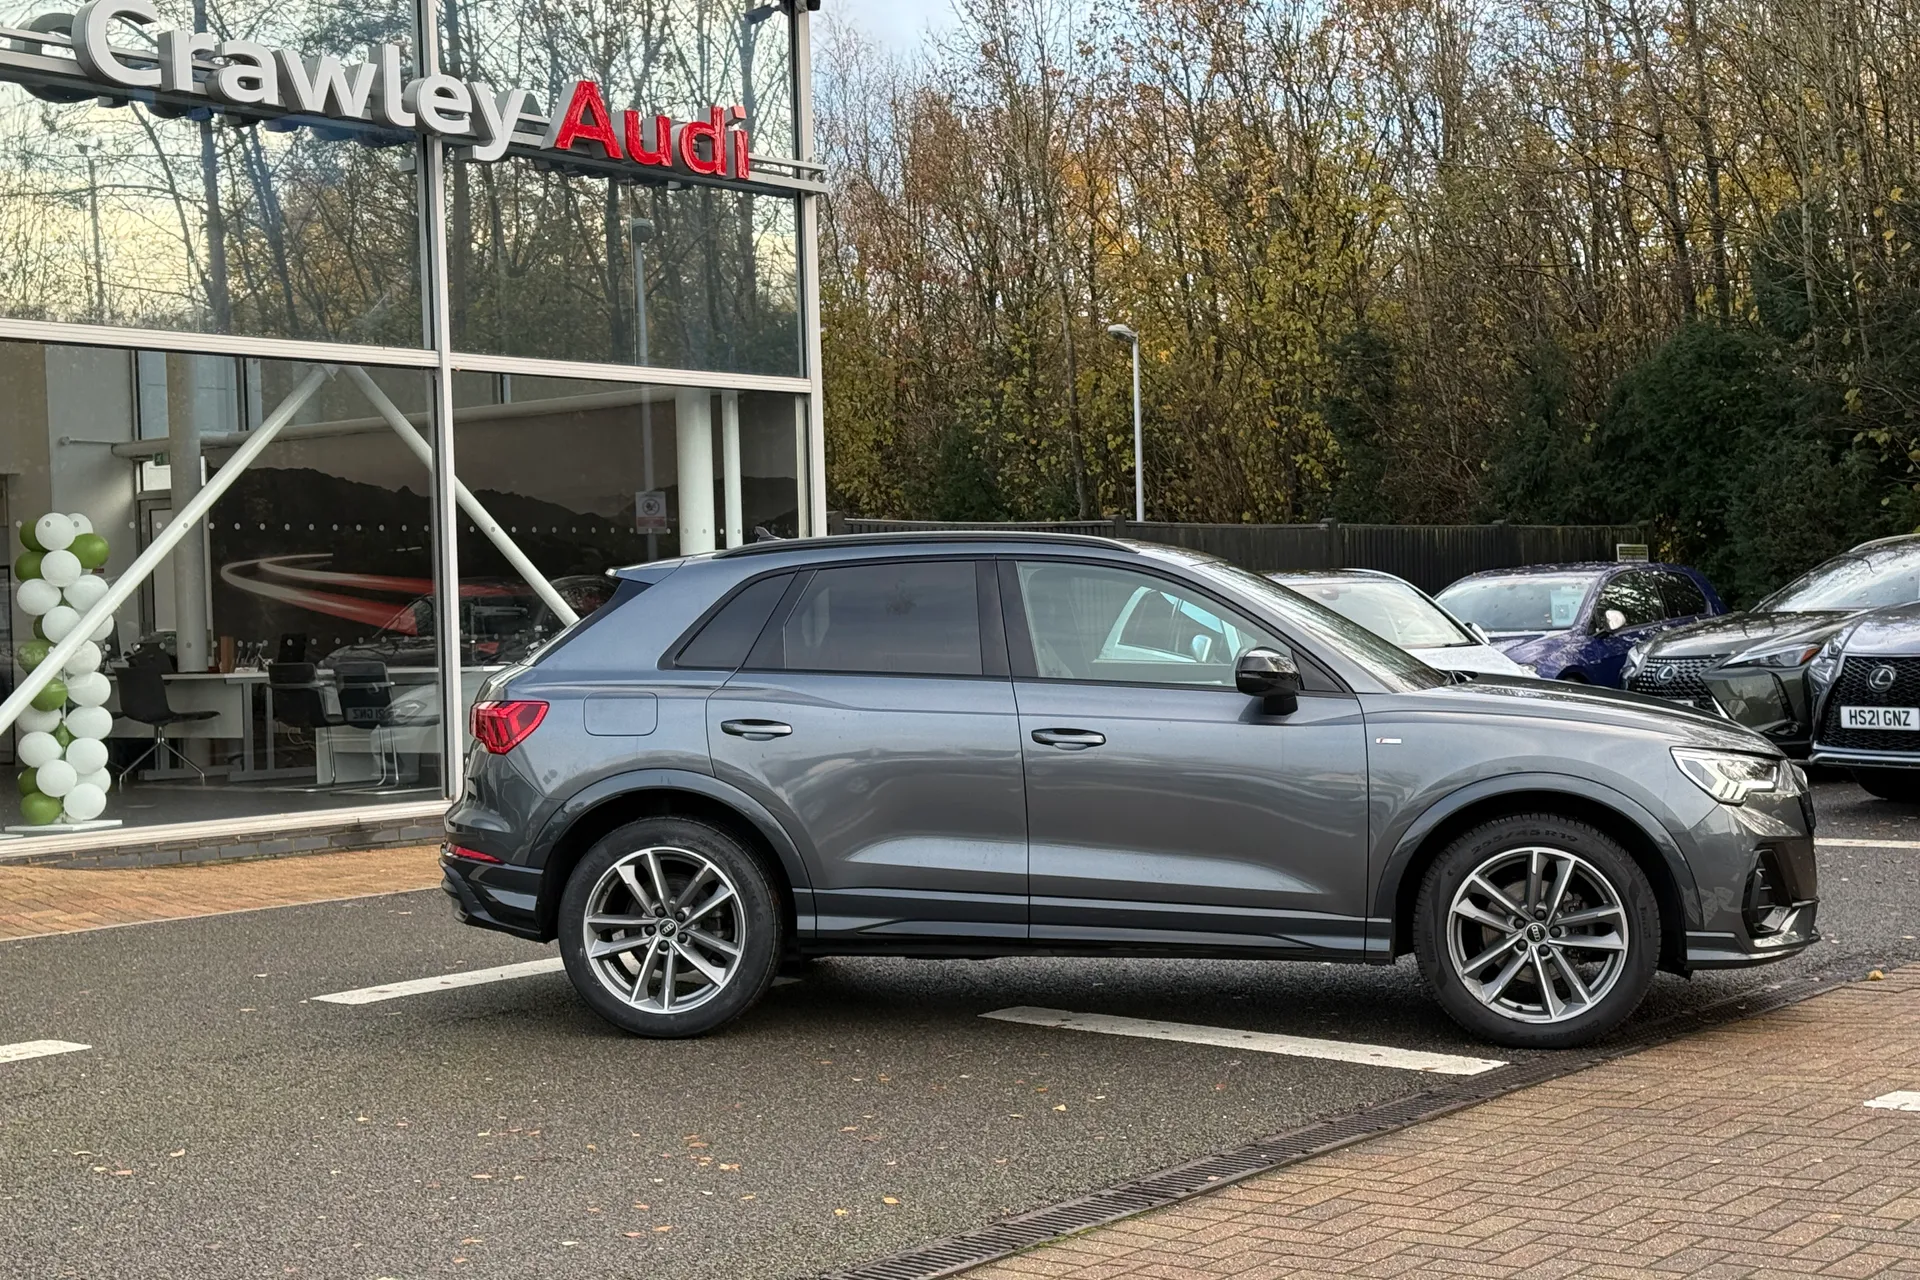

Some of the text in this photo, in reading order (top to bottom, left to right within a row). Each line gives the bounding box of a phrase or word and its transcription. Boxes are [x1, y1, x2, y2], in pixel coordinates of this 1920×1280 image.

[73, 0, 750, 180] Crawley Audi
[1849, 709, 1911, 727] HS21 GNZ
